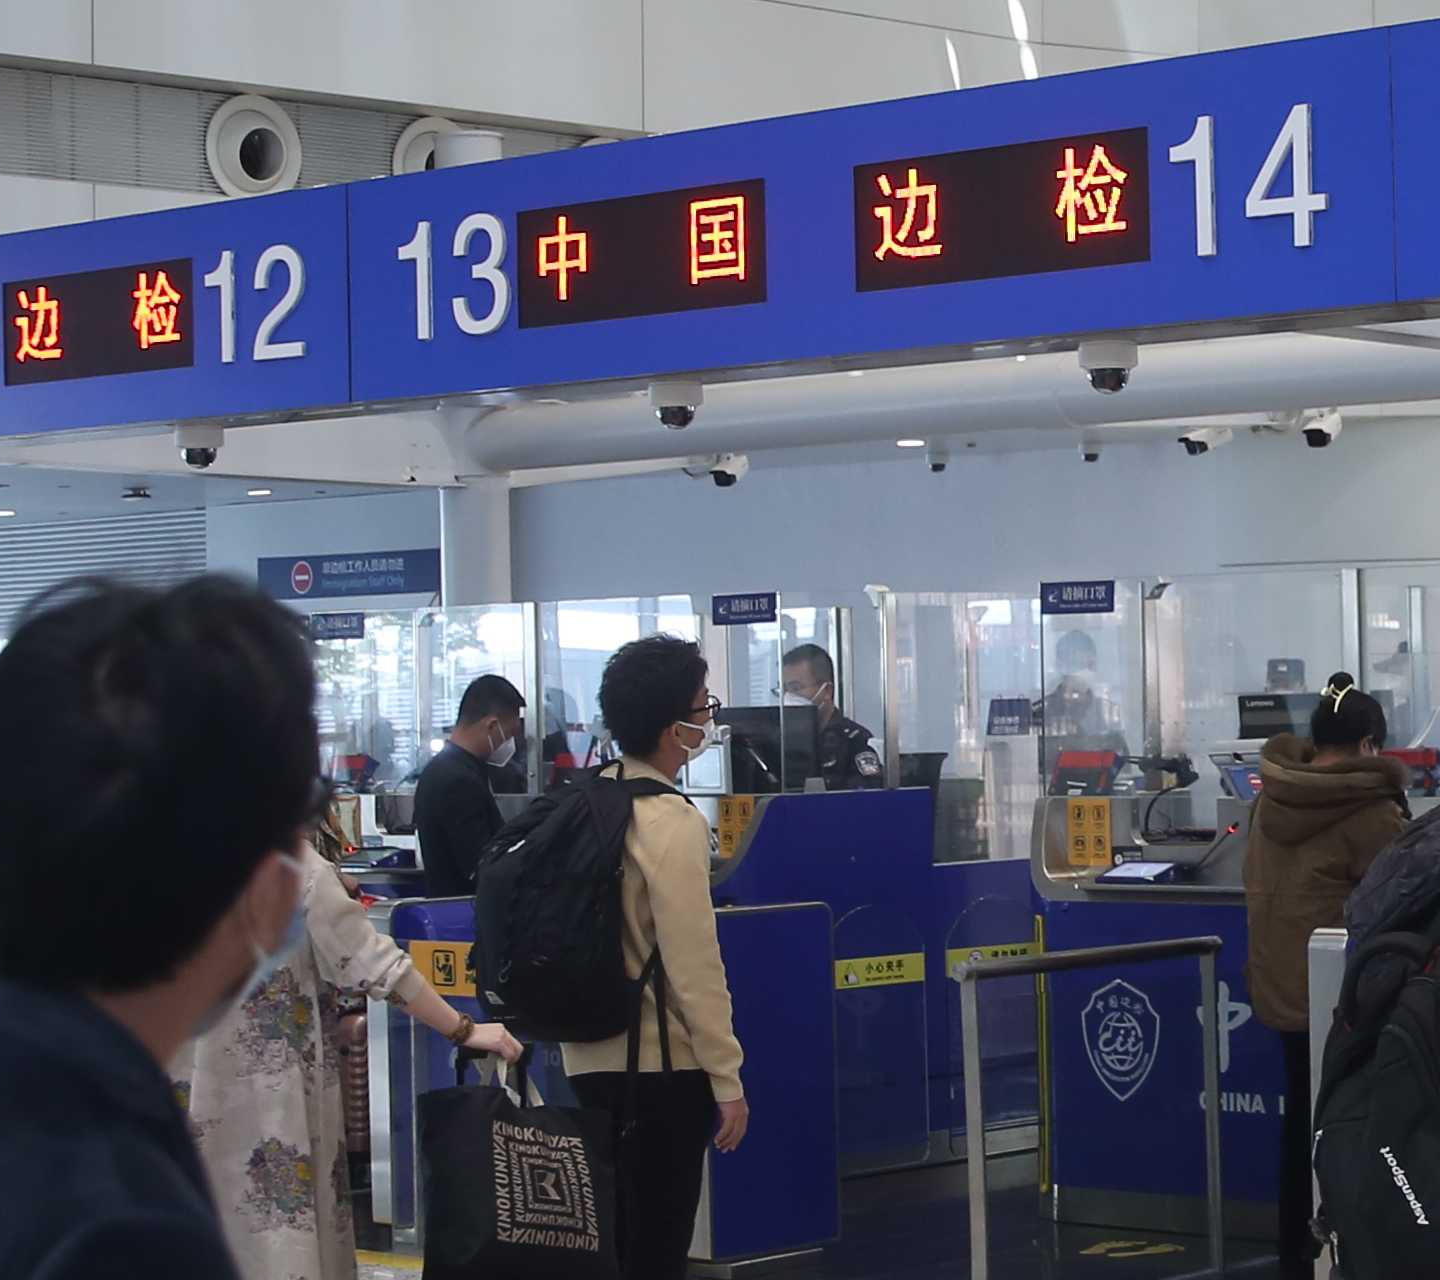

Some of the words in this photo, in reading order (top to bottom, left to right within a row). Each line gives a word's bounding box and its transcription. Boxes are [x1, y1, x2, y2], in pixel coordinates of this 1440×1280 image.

[873, 143, 1129, 262] 边检
[1169, 103, 1330, 258] 14
[398, 213, 511, 341] 13
[537, 195, 747, 302] 中国
[14, 269, 182, 363] 边检
[205, 244, 307, 363] 12
[492, 1119, 570, 1149] KINOKUNIYA
[492, 1134, 511, 1242] KINOKUNIYA
[1379, 1146, 1429, 1225] AspenSport
